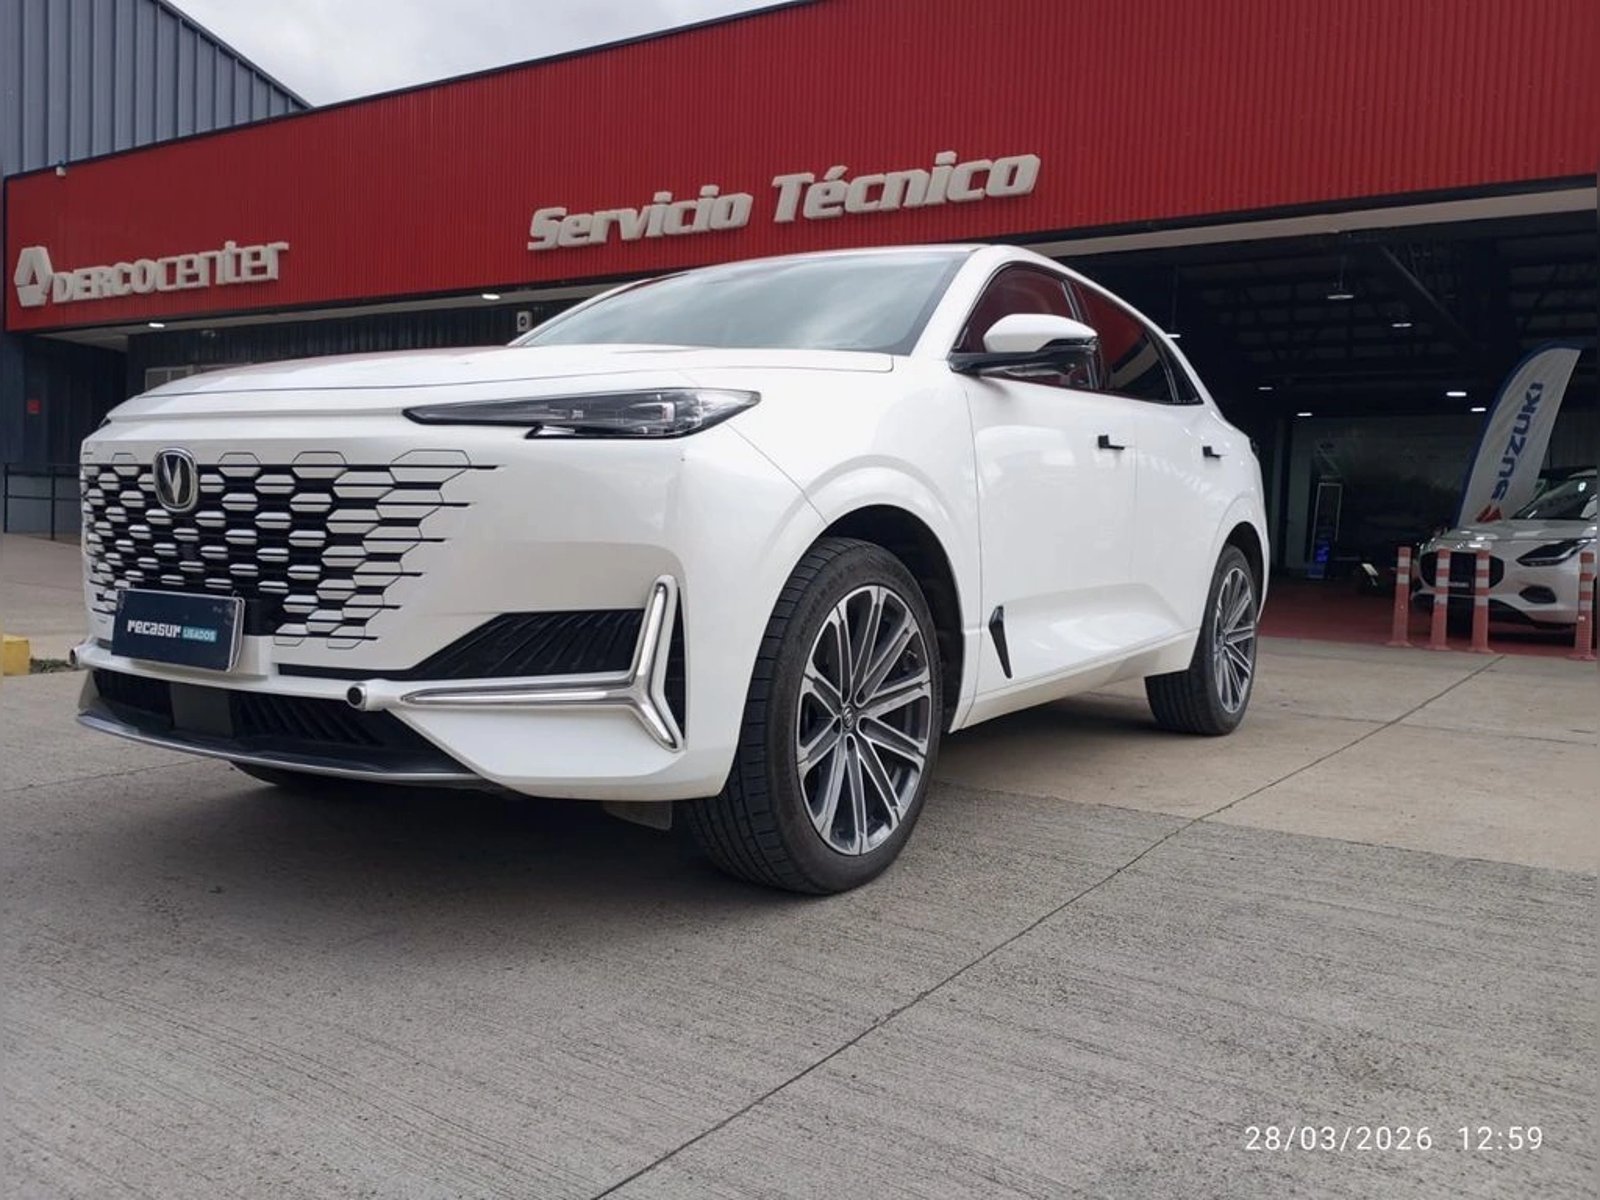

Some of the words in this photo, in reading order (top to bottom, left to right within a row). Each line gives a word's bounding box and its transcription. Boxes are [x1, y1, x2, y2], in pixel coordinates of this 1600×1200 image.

[527, 184, 753, 251] Servicio
[772, 150, 1041, 223] Técnico
[1491, 382, 1544, 501] SUZUKI
[127, 619, 182, 639] recasur
[183, 626, 217, 642] USADOS
